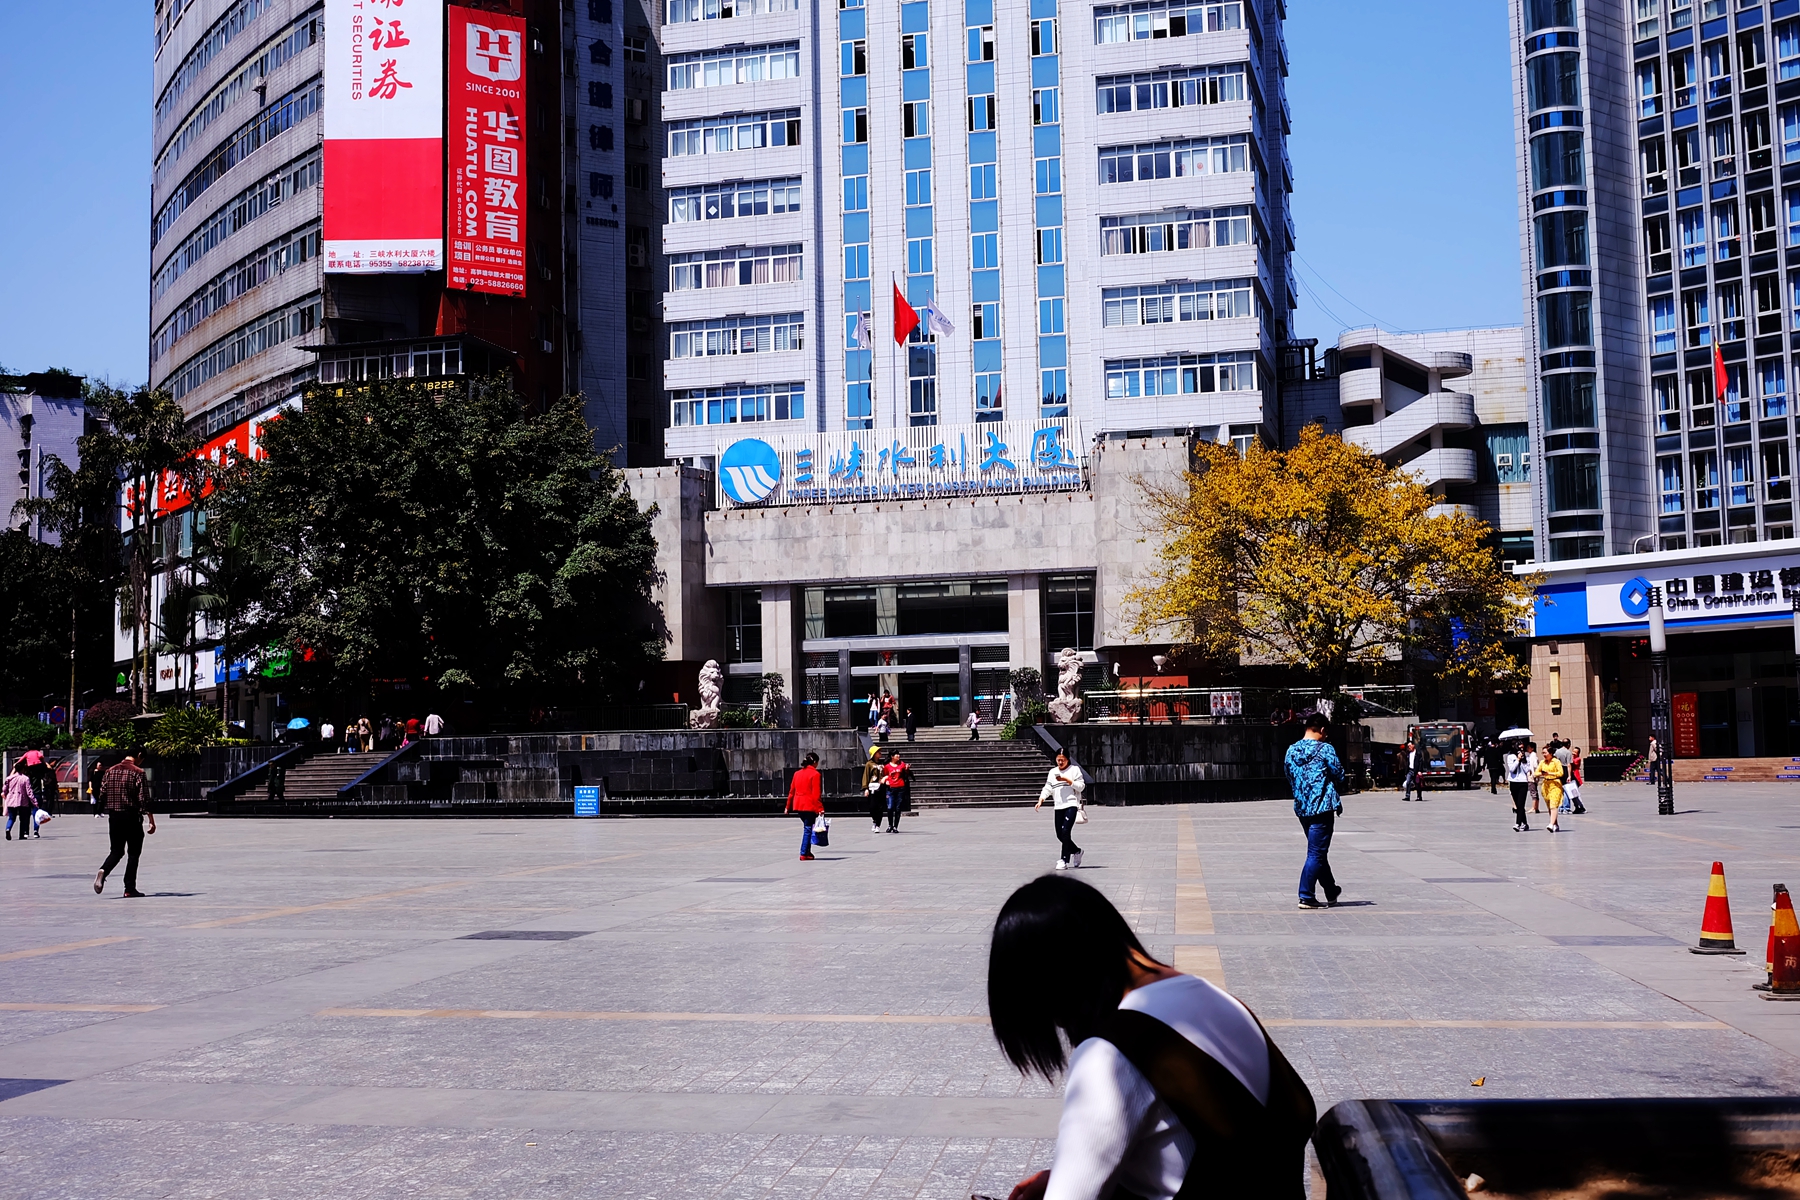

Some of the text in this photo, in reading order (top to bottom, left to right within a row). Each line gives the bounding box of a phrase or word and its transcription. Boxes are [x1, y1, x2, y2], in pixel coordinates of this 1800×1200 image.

[352, 15, 363, 100] SECURITIES
[465, 82, 520, 99] SINCE 2001
[466, 107, 478, 237] HUATU.COM
[483, 110, 519, 243] 华图教育
[454, 241, 471, 251] 培训
[454, 251, 471, 261] 项目
[794, 425, 1081, 483] 三峡水利大厦
[787, 473, 1081, 499] THREE GORGES WATER CONSERVANCY BUILDING
[1666, 596, 1699, 609] China
[1703, 590, 1778, 606] Construction
